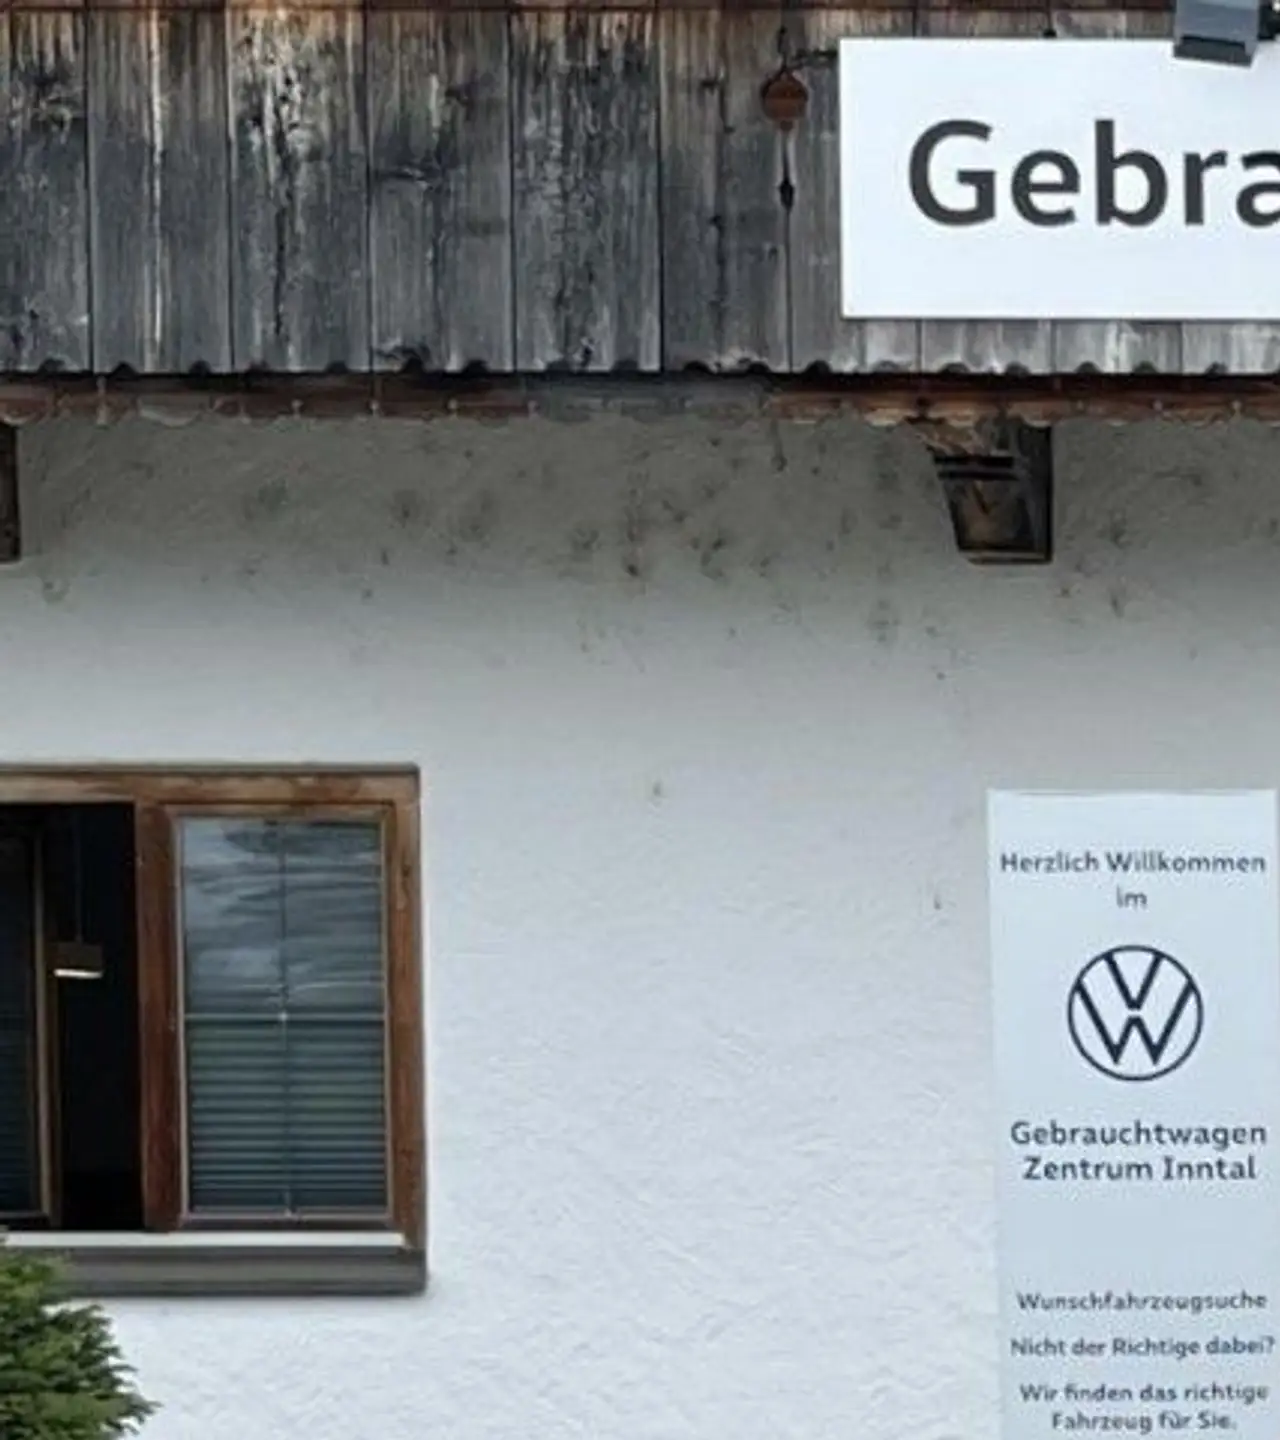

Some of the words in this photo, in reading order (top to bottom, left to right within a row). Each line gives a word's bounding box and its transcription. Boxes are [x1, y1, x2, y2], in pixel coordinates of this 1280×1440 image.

[1000, 852, 1099, 874] Herzlich
[1105, 852, 1267, 875] Willkommen
[1116, 886, 1148, 908] im
[1068, 945, 1204, 1082] VW
[1009, 1120, 1268, 1152] Gebrauchtwagen
[1022, 1156, 1154, 1181] Zentrum
[1162, 1156, 1258, 1181] Inntal
[1017, 1290, 1268, 1313] Wunschfahrzeugsuche
[1010, 1338, 1066, 1357] Nicht
[1072, 1338, 1106, 1357] der
[1112, 1337, 1201, 1360] Richtige
[1205, 1335, 1275, 1356] dabei?
[1019, 1384, 1058, 1402] Wir
[1064, 1383, 1133, 1402] finden
[1139, 1383, 1177, 1402] das
[1183, 1383, 1270, 1406] richtige
[1051, 1412, 1154, 1434] Fahrzeug
[1159, 1411, 1191, 1430] für
[1198, 1411, 1237, 1431] Sie.
